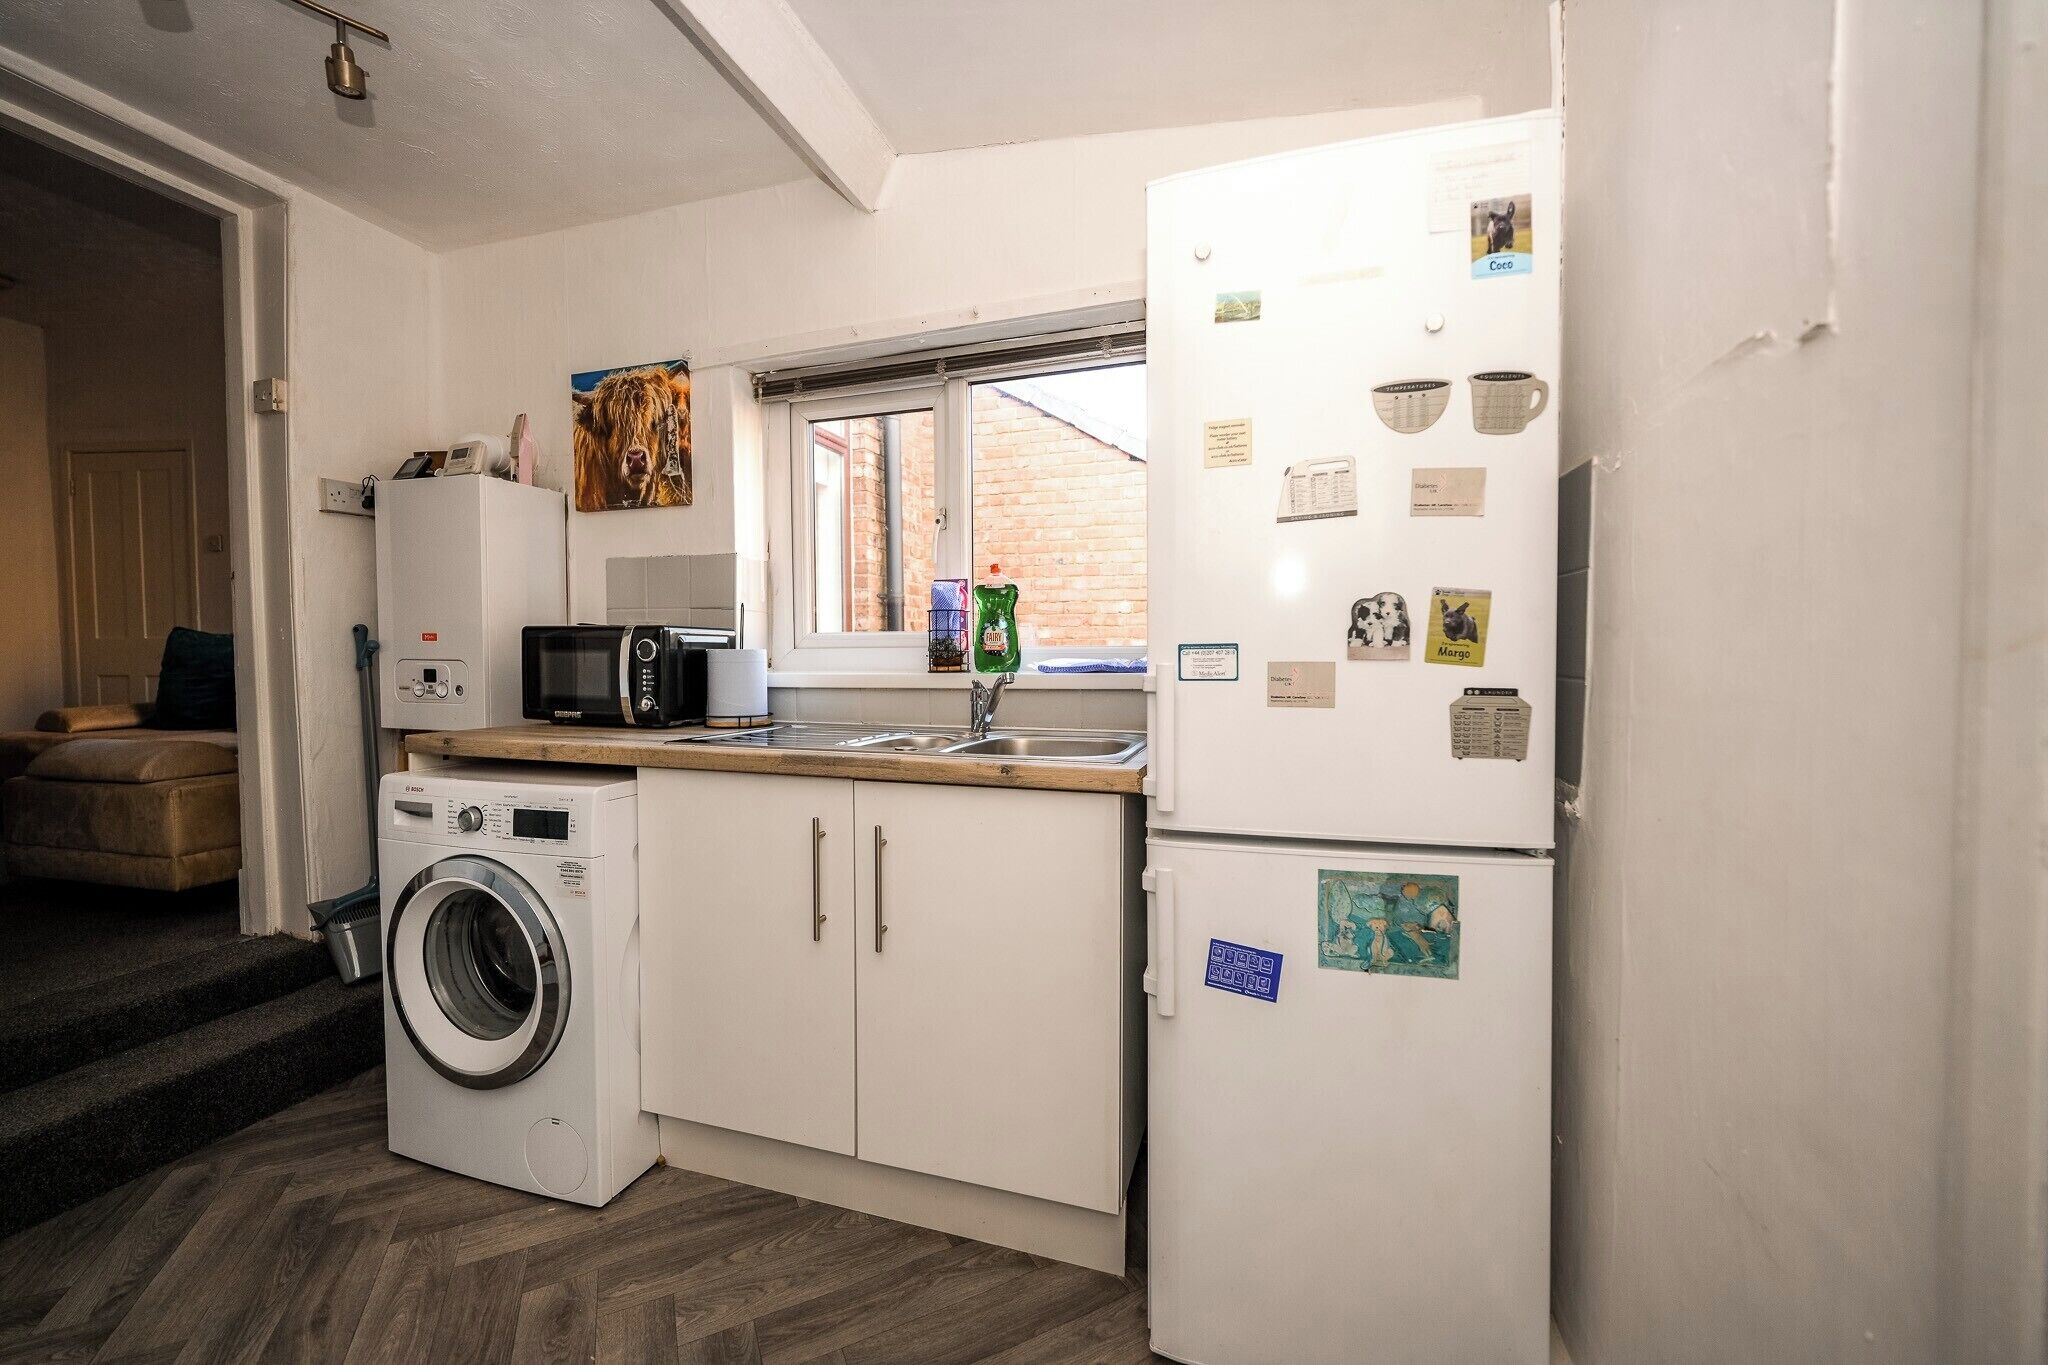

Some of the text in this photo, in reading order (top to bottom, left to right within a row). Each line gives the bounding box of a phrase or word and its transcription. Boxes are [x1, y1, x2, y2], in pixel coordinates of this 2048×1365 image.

[1489, 259, 1513, 271] Coco
[1386, 382, 1436, 392] TEMPERATURES
[986, 632, 1002, 642] FAIRY
[1437, 646, 1471, 660] Margo
